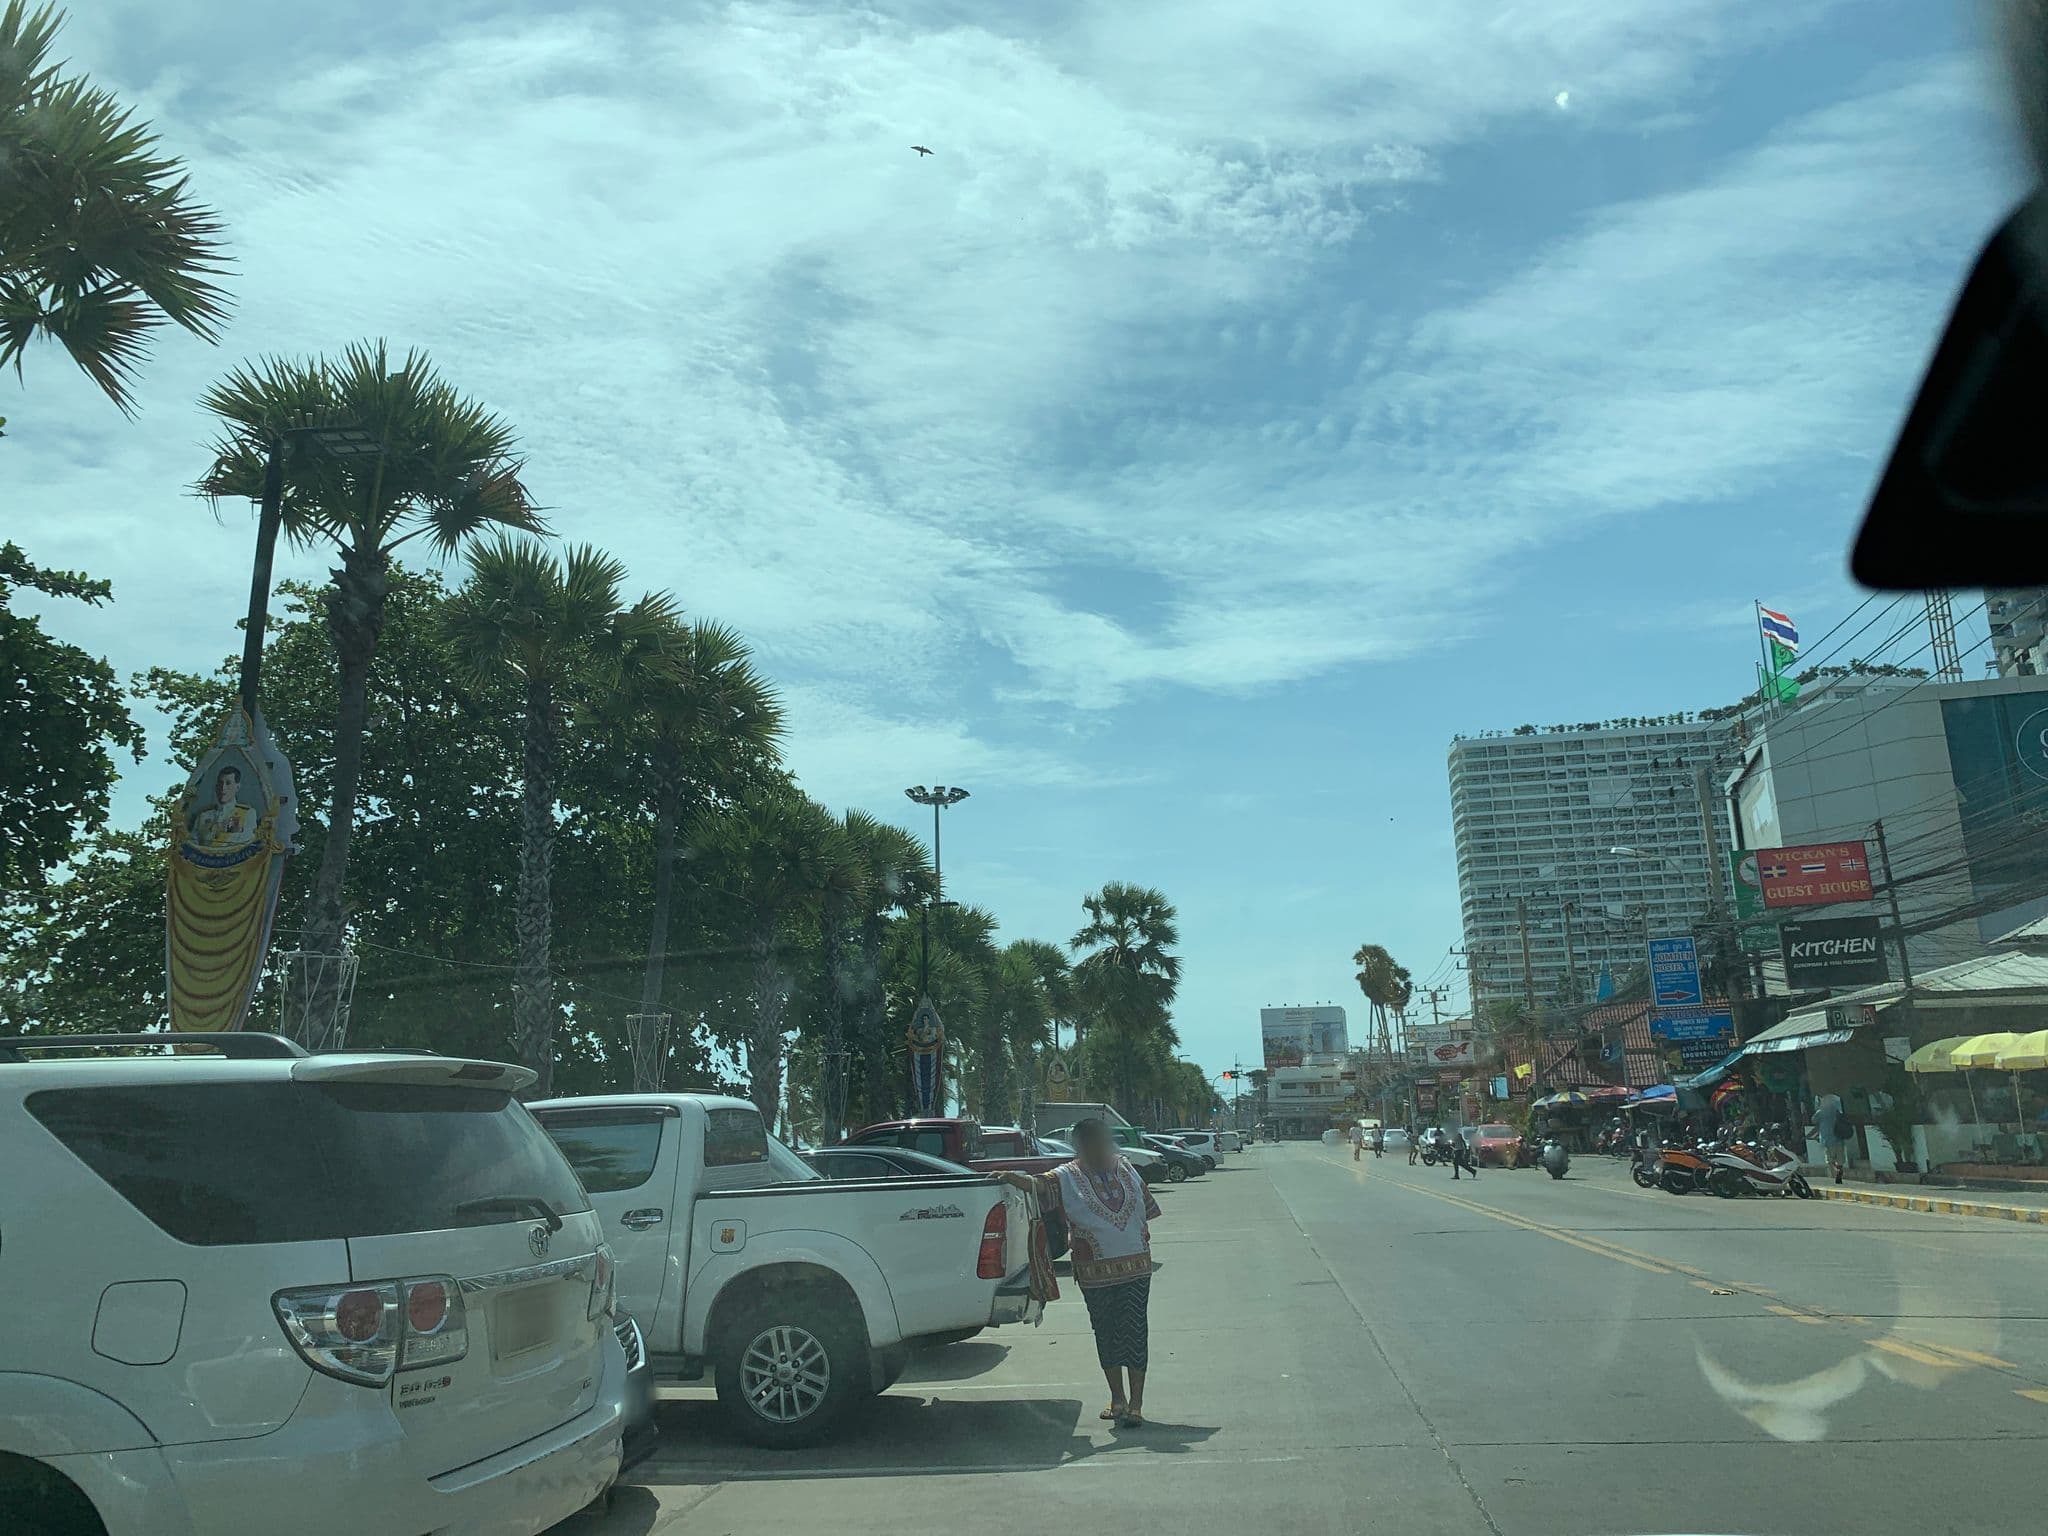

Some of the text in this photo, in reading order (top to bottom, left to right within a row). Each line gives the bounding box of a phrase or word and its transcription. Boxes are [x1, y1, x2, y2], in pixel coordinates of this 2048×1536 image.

[1772, 847, 1850, 862] VICKAN'S
[1766, 879, 1870, 899] GUEST HOUSE
[1791, 937, 1877, 958] KITCHEN
